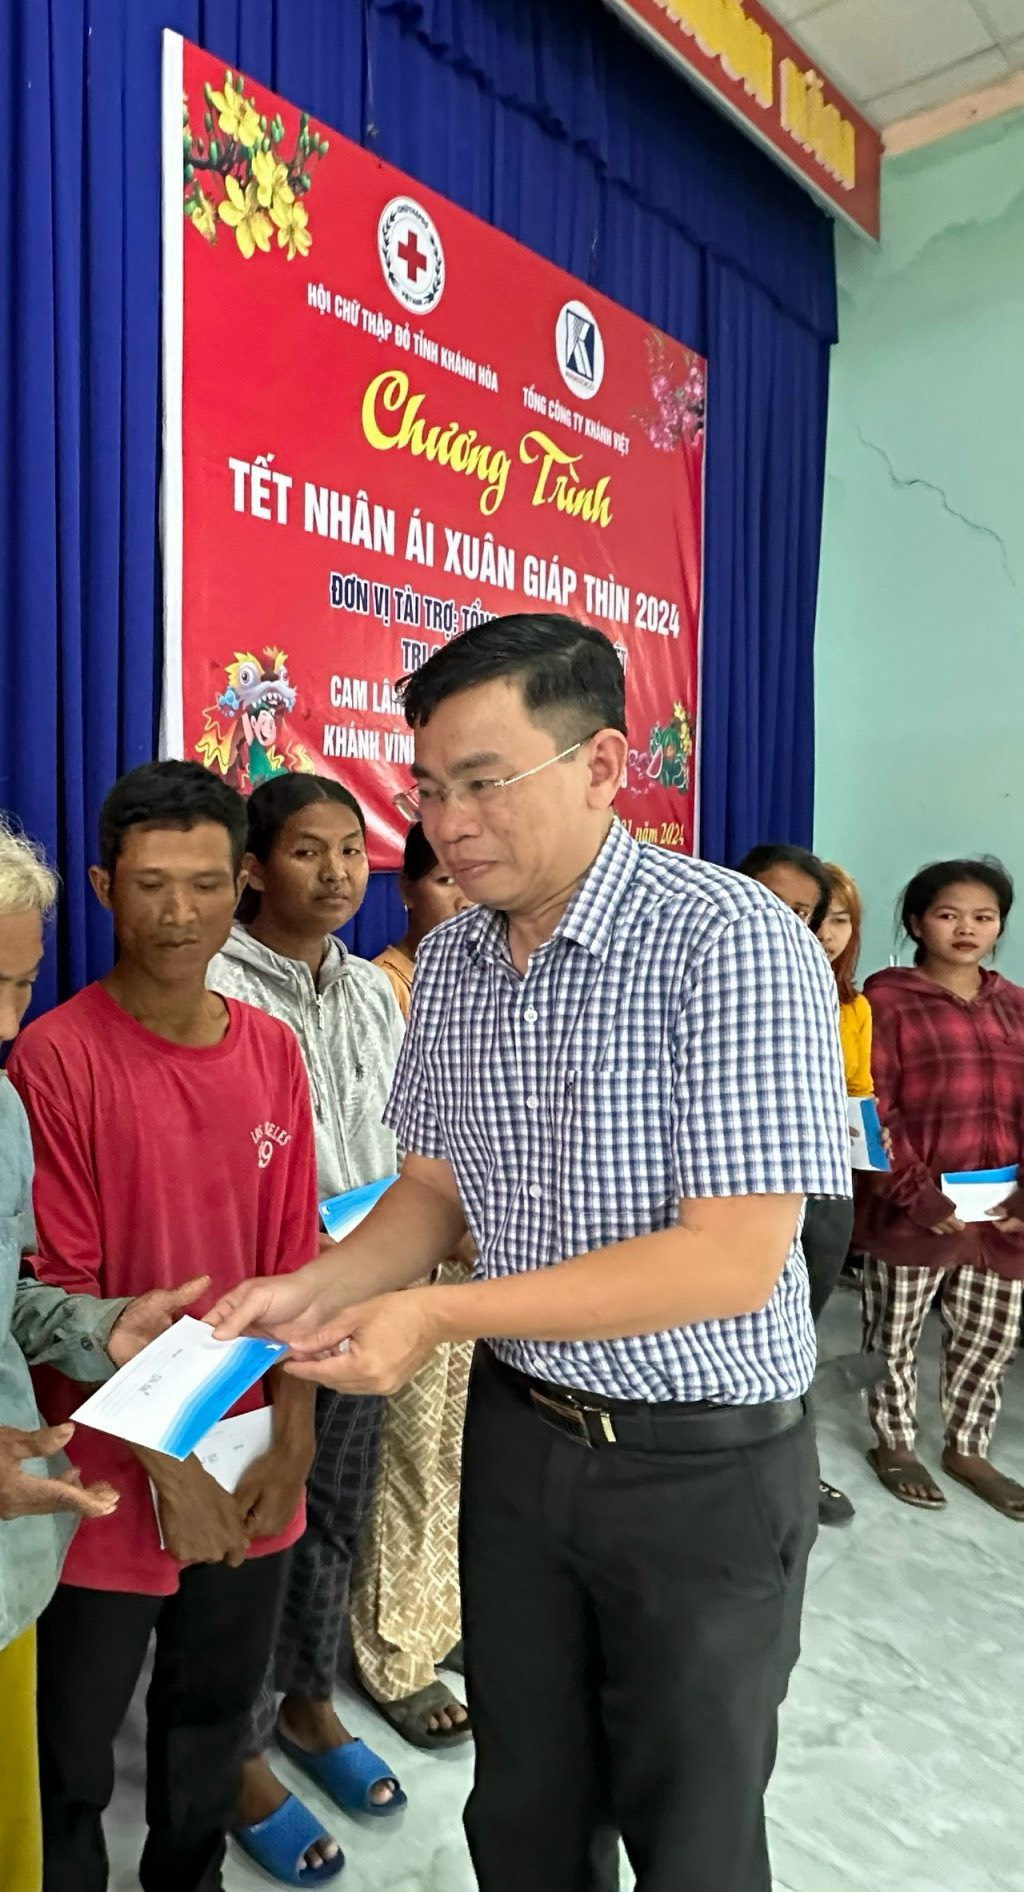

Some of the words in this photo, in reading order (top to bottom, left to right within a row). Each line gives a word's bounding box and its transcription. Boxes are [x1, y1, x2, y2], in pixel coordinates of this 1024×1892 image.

[307, 283, 331, 315] HỘI
[334, 295, 361, 327] CHỮ
[362, 309, 392, 343] THẬP
[395, 322, 410, 351] ĐỎ
[413, 329, 439, 364] TỈNH
[440, 347, 477, 382] KHÁNH
[361, 370, 511, 516] Chương
[519, 430, 613, 528] Trình
[228, 452, 293, 526] TẾT
[304, 481, 395, 557] NHÂN
[405, 507, 434, 568] ÁI
[443, 527, 515, 592] XUÂN
[523, 554, 577, 607] GIÁP
[583, 573, 630, 625] THÌN
[634, 592, 680, 640] 2024
[331, 572, 368, 613] ĐƠN
[373, 583, 391, 626] VỊ
[394, 585, 421, 626] TÀI
[424, 599, 458, 640] TRỢ:
[461, 597, 499, 634] TỔ
[330, 675, 368, 711] CAM
[323, 721, 380, 761] KHÁNH
[636, 821, 658, 843] năm
[660, 822, 685, 846] 2024
